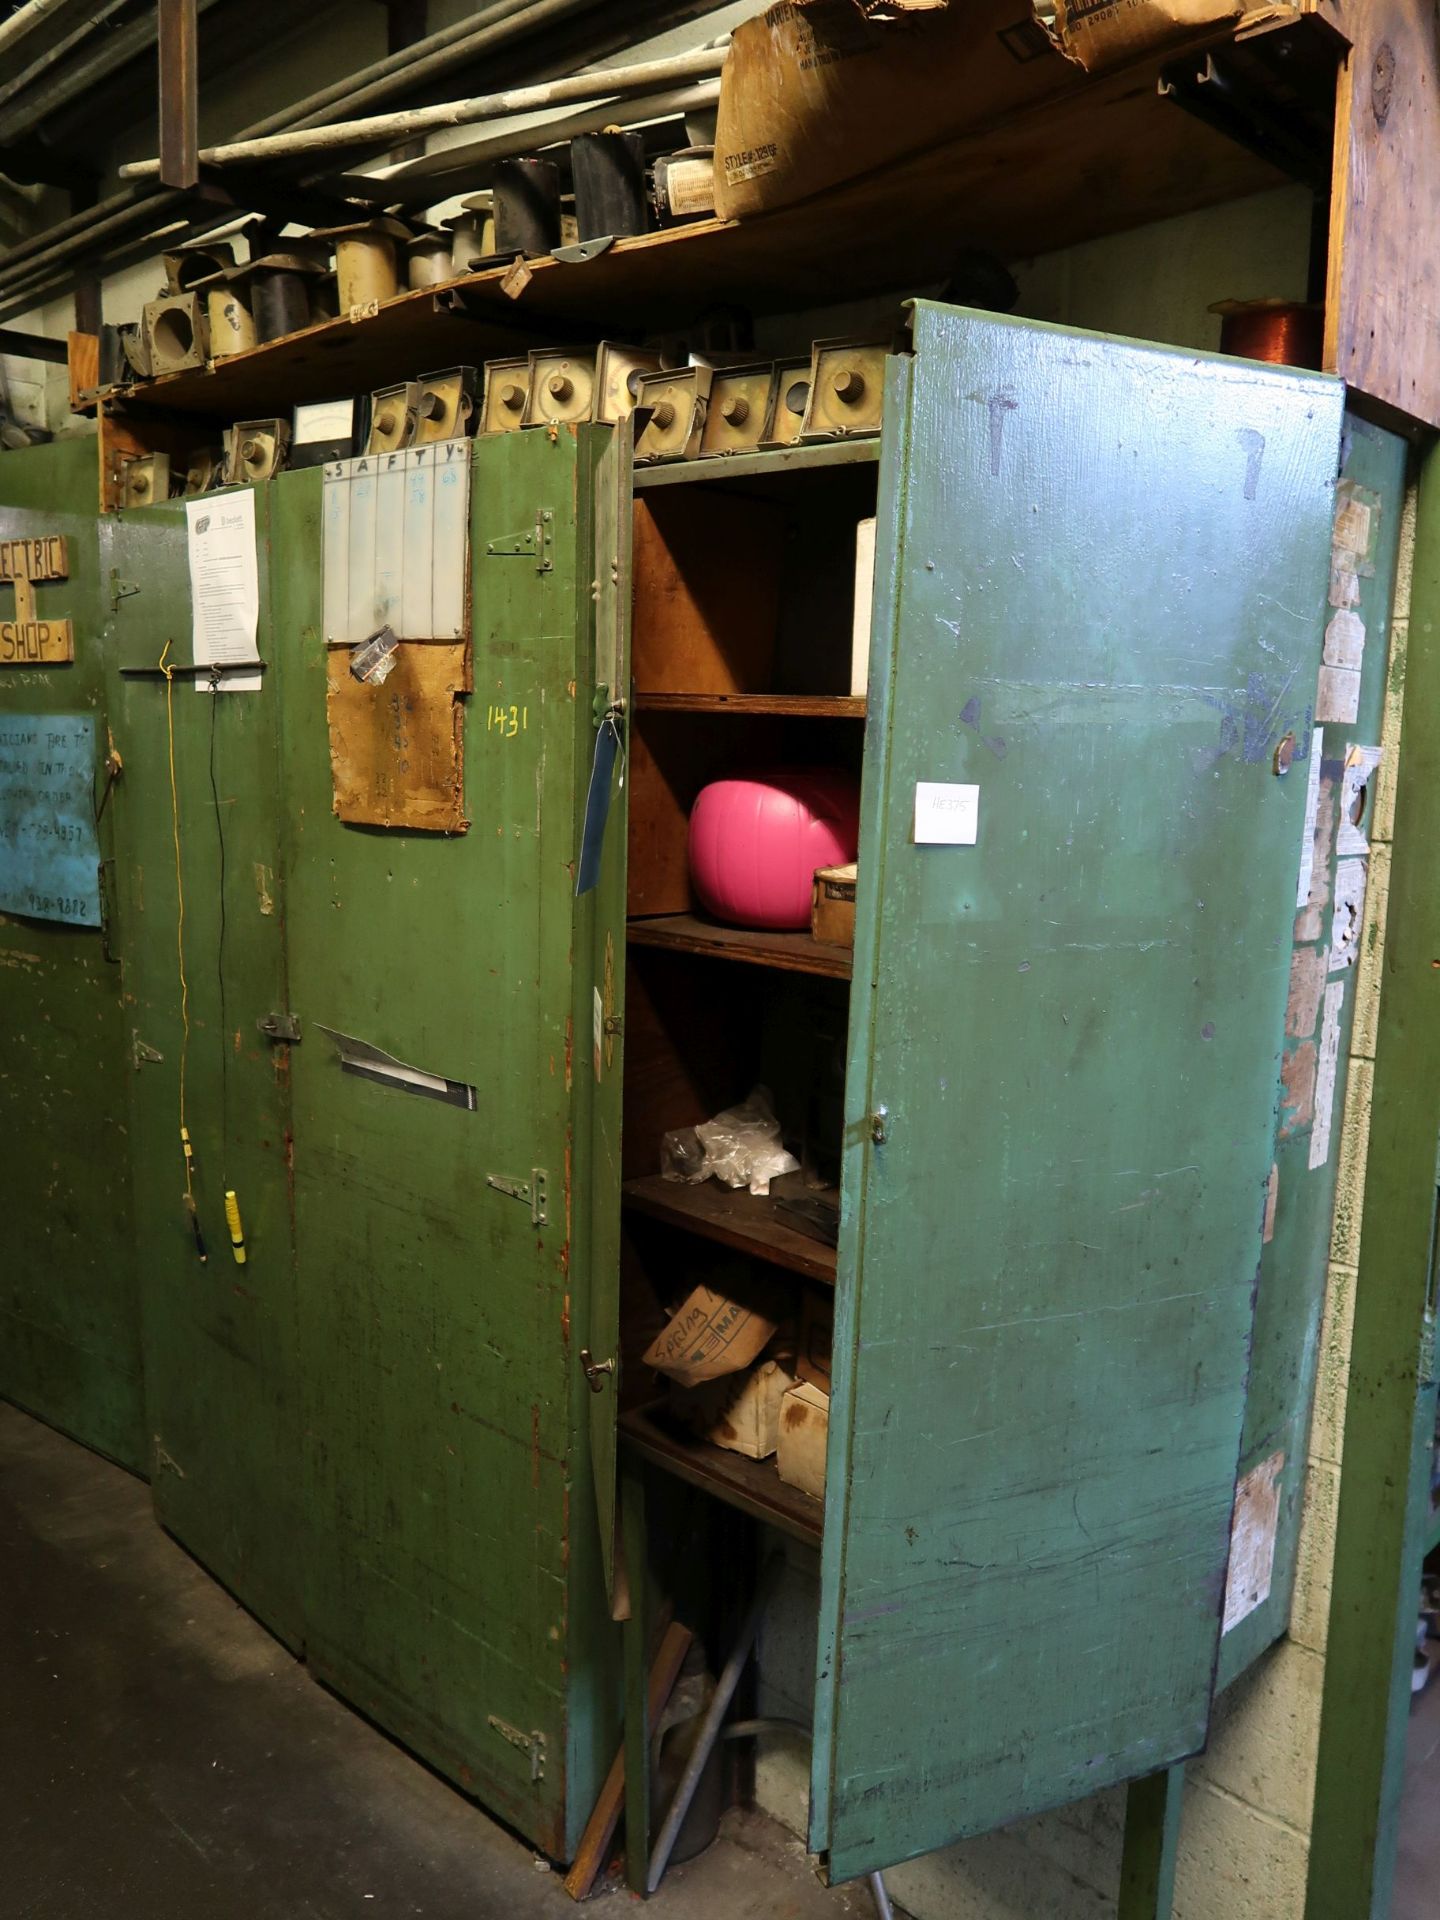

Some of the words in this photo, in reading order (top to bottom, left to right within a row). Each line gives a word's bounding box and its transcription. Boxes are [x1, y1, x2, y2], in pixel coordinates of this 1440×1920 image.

[0, 536, 60, 580] ECTRIC
[2, 623, 50, 661] SHOP
[487, 705, 528, 738] 1431
